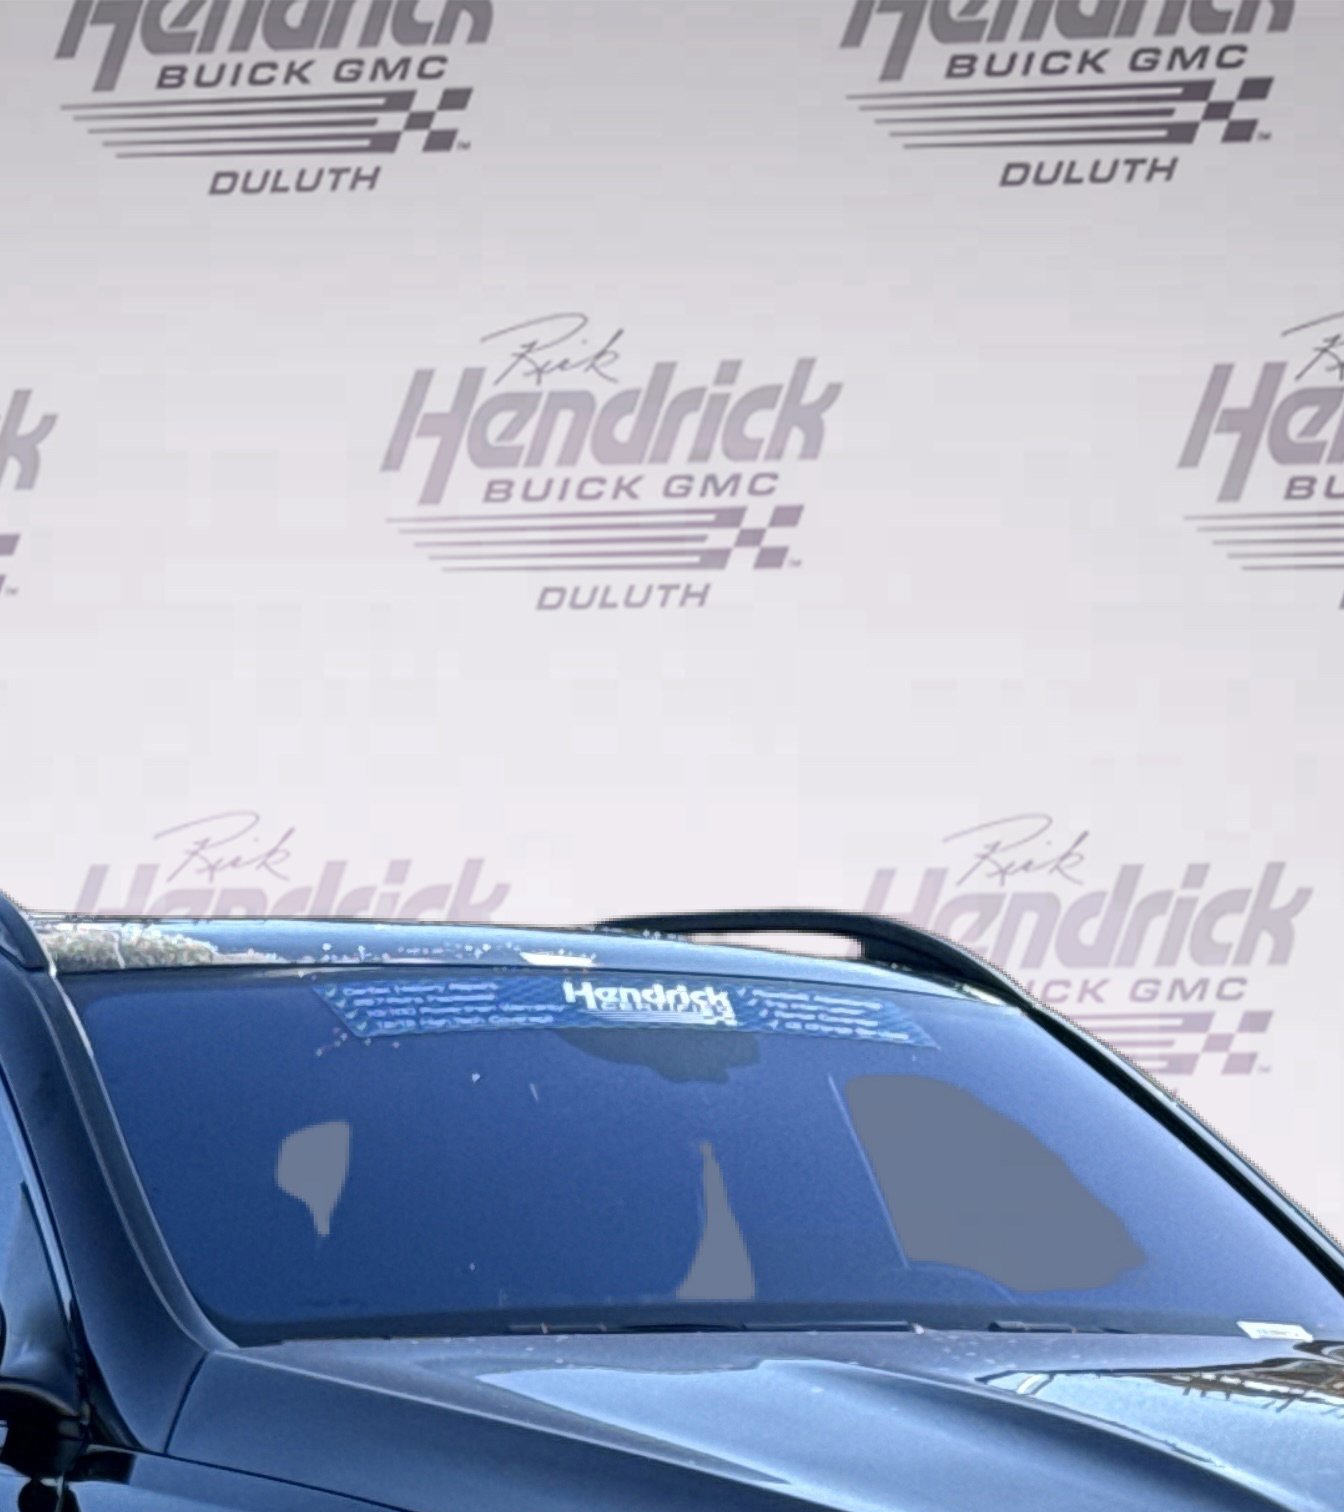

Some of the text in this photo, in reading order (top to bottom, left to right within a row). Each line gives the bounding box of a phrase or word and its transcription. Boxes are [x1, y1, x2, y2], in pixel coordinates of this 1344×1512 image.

[156, 55, 448, 89] BUICK GMC
[945, 44, 1248, 79] BUICK GMC
[209, 166, 381, 195] DULUTH
[999, 157, 1178, 187] DULUTH
[380, 357, 843, 505] Hendrick
[483, 472, 779, 503] BUICK GMC
[536, 583, 711, 610] DULUTH
[562, 981, 734, 1016] Hendrick
[1129, 976, 1248, 1001] GMC
